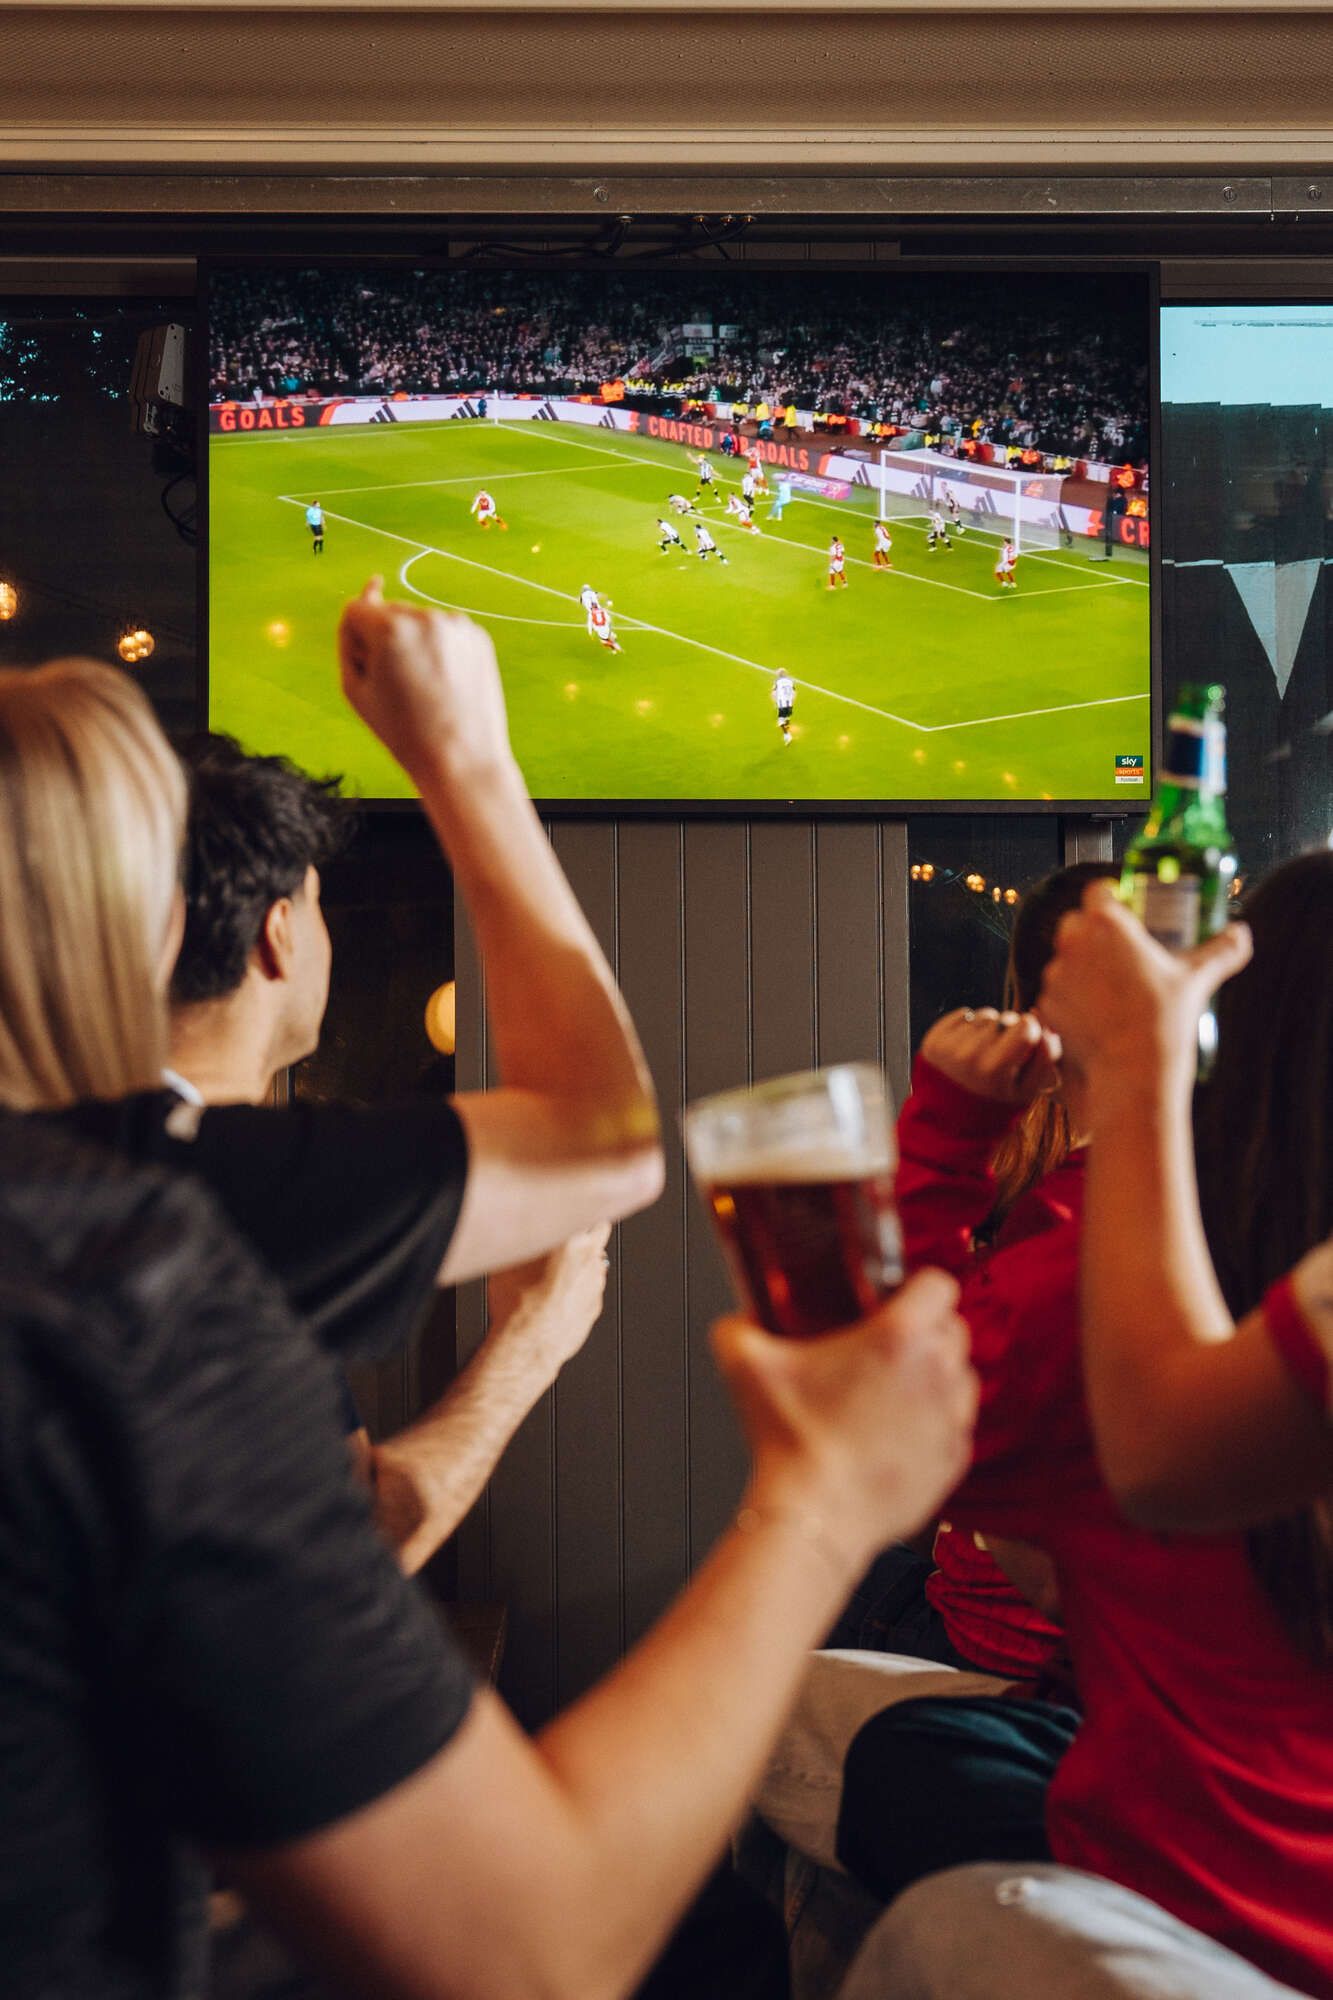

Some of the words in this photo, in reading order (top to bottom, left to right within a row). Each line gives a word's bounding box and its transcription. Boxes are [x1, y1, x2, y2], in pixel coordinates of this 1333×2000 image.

[220, 406, 305, 431] GOALS
[648, 415, 713, 449] CRAFTED
[755, 439, 809, 471] GOALS
[1121, 756, 1137, 767] sky
